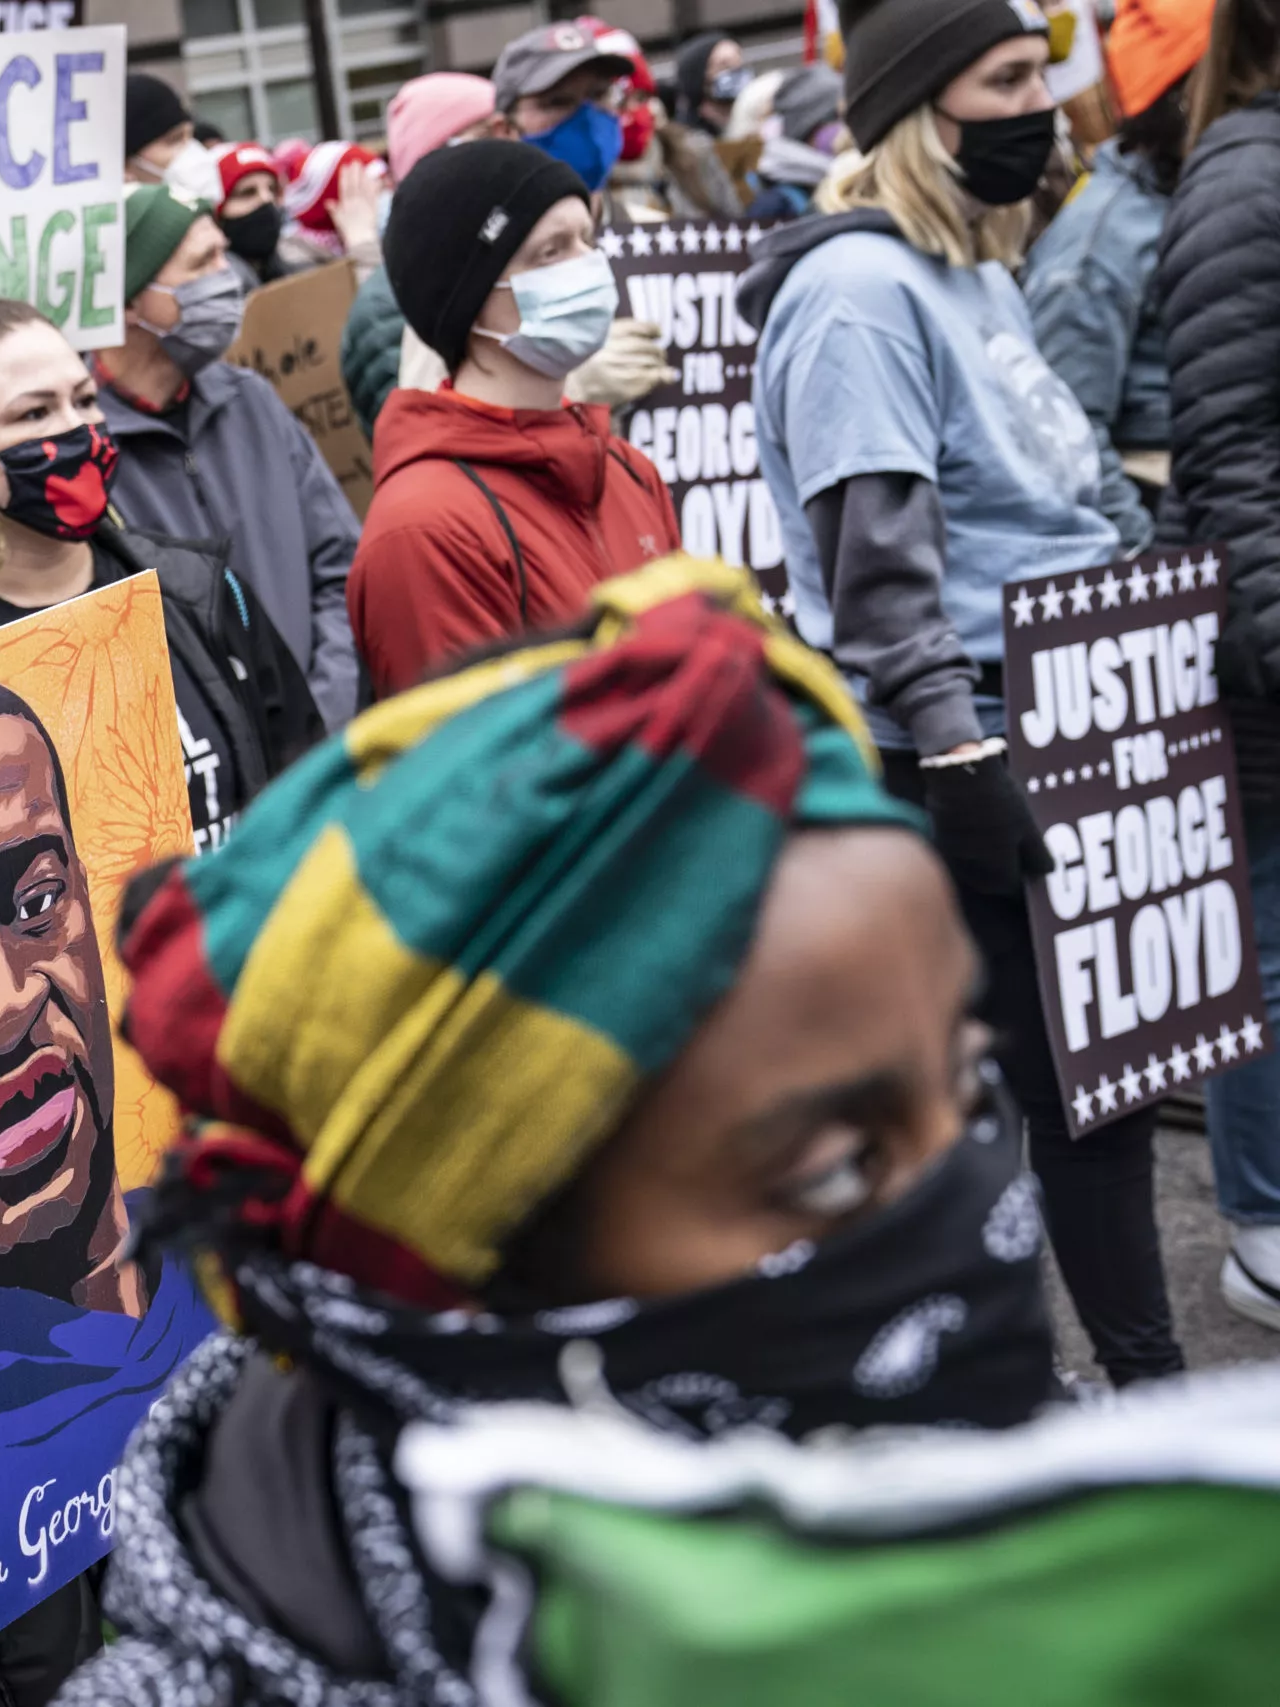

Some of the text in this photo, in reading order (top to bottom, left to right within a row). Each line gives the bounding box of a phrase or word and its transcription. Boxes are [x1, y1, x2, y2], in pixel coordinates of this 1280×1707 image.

[681, 351, 725, 395] FOR
[680, 477, 786, 571] OYD
[1020, 611, 1219, 749] JUSTICE
[1112, 729, 1169, 791] FOR
[1042, 774, 1234, 921] GEORGE
[1053, 878, 1242, 1053] FLOYD
